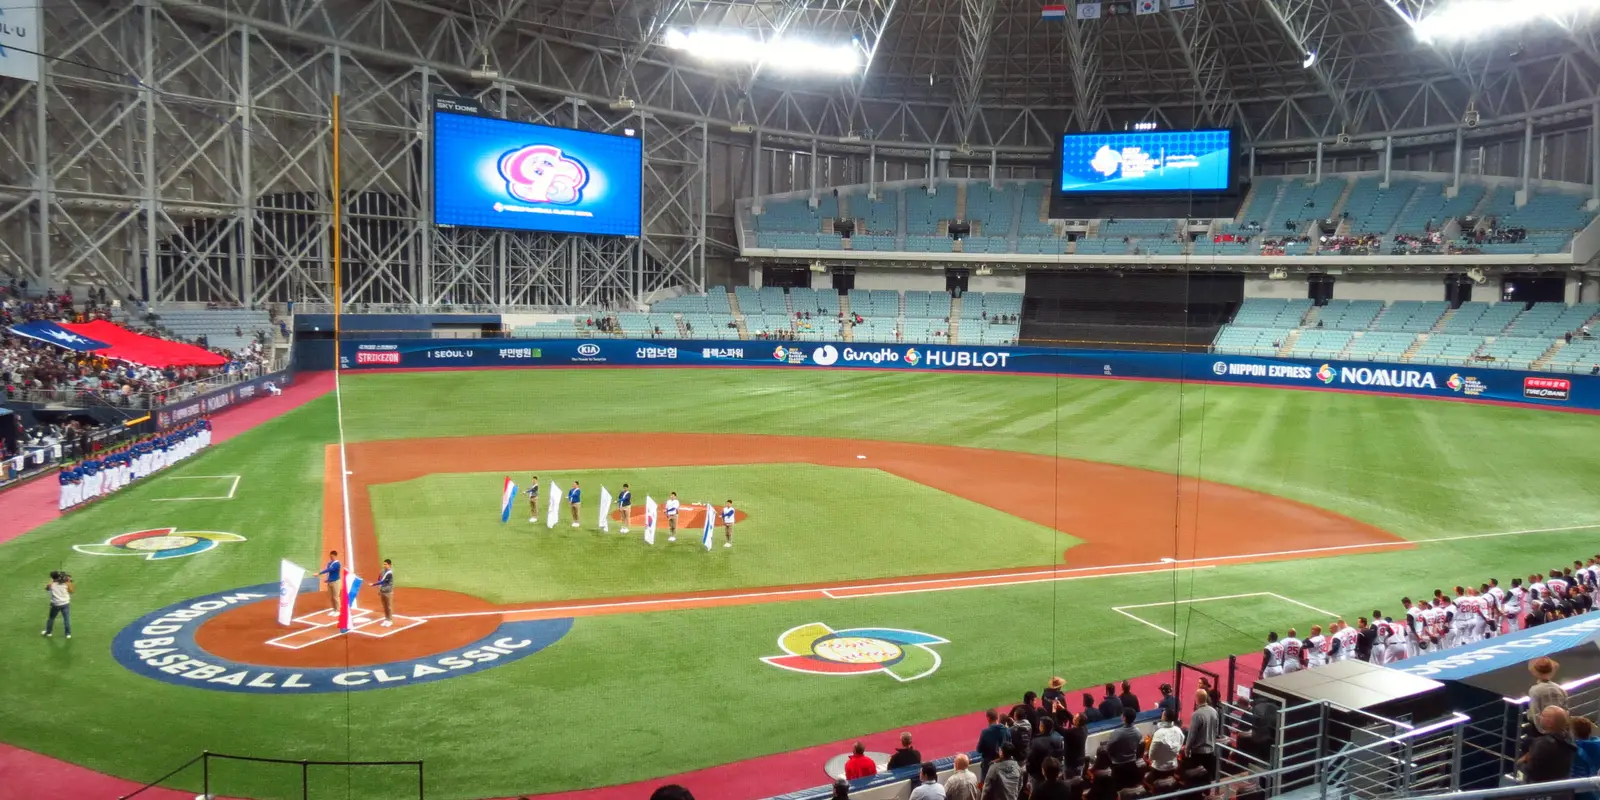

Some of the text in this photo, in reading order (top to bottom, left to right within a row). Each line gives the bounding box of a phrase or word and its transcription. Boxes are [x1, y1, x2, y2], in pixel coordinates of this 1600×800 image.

[436, 102, 478, 113] SKY DOME
[358, 352, 399, 363] STRIKEZON
[635, 347, 678, 359] 신협보험
[702, 348, 744, 359] 플렉스파워
[843, 347, 899, 363] GungHo
[926, 350, 1010, 367] HUBLOT
[1229, 363, 1312, 379] NIPPON EXPRESS
[1341, 367, 1437, 389] NOMURA
[133, 592, 532, 688] WORLD BASEBALL CLASSIC
[1287, 645, 1299, 656] 25
